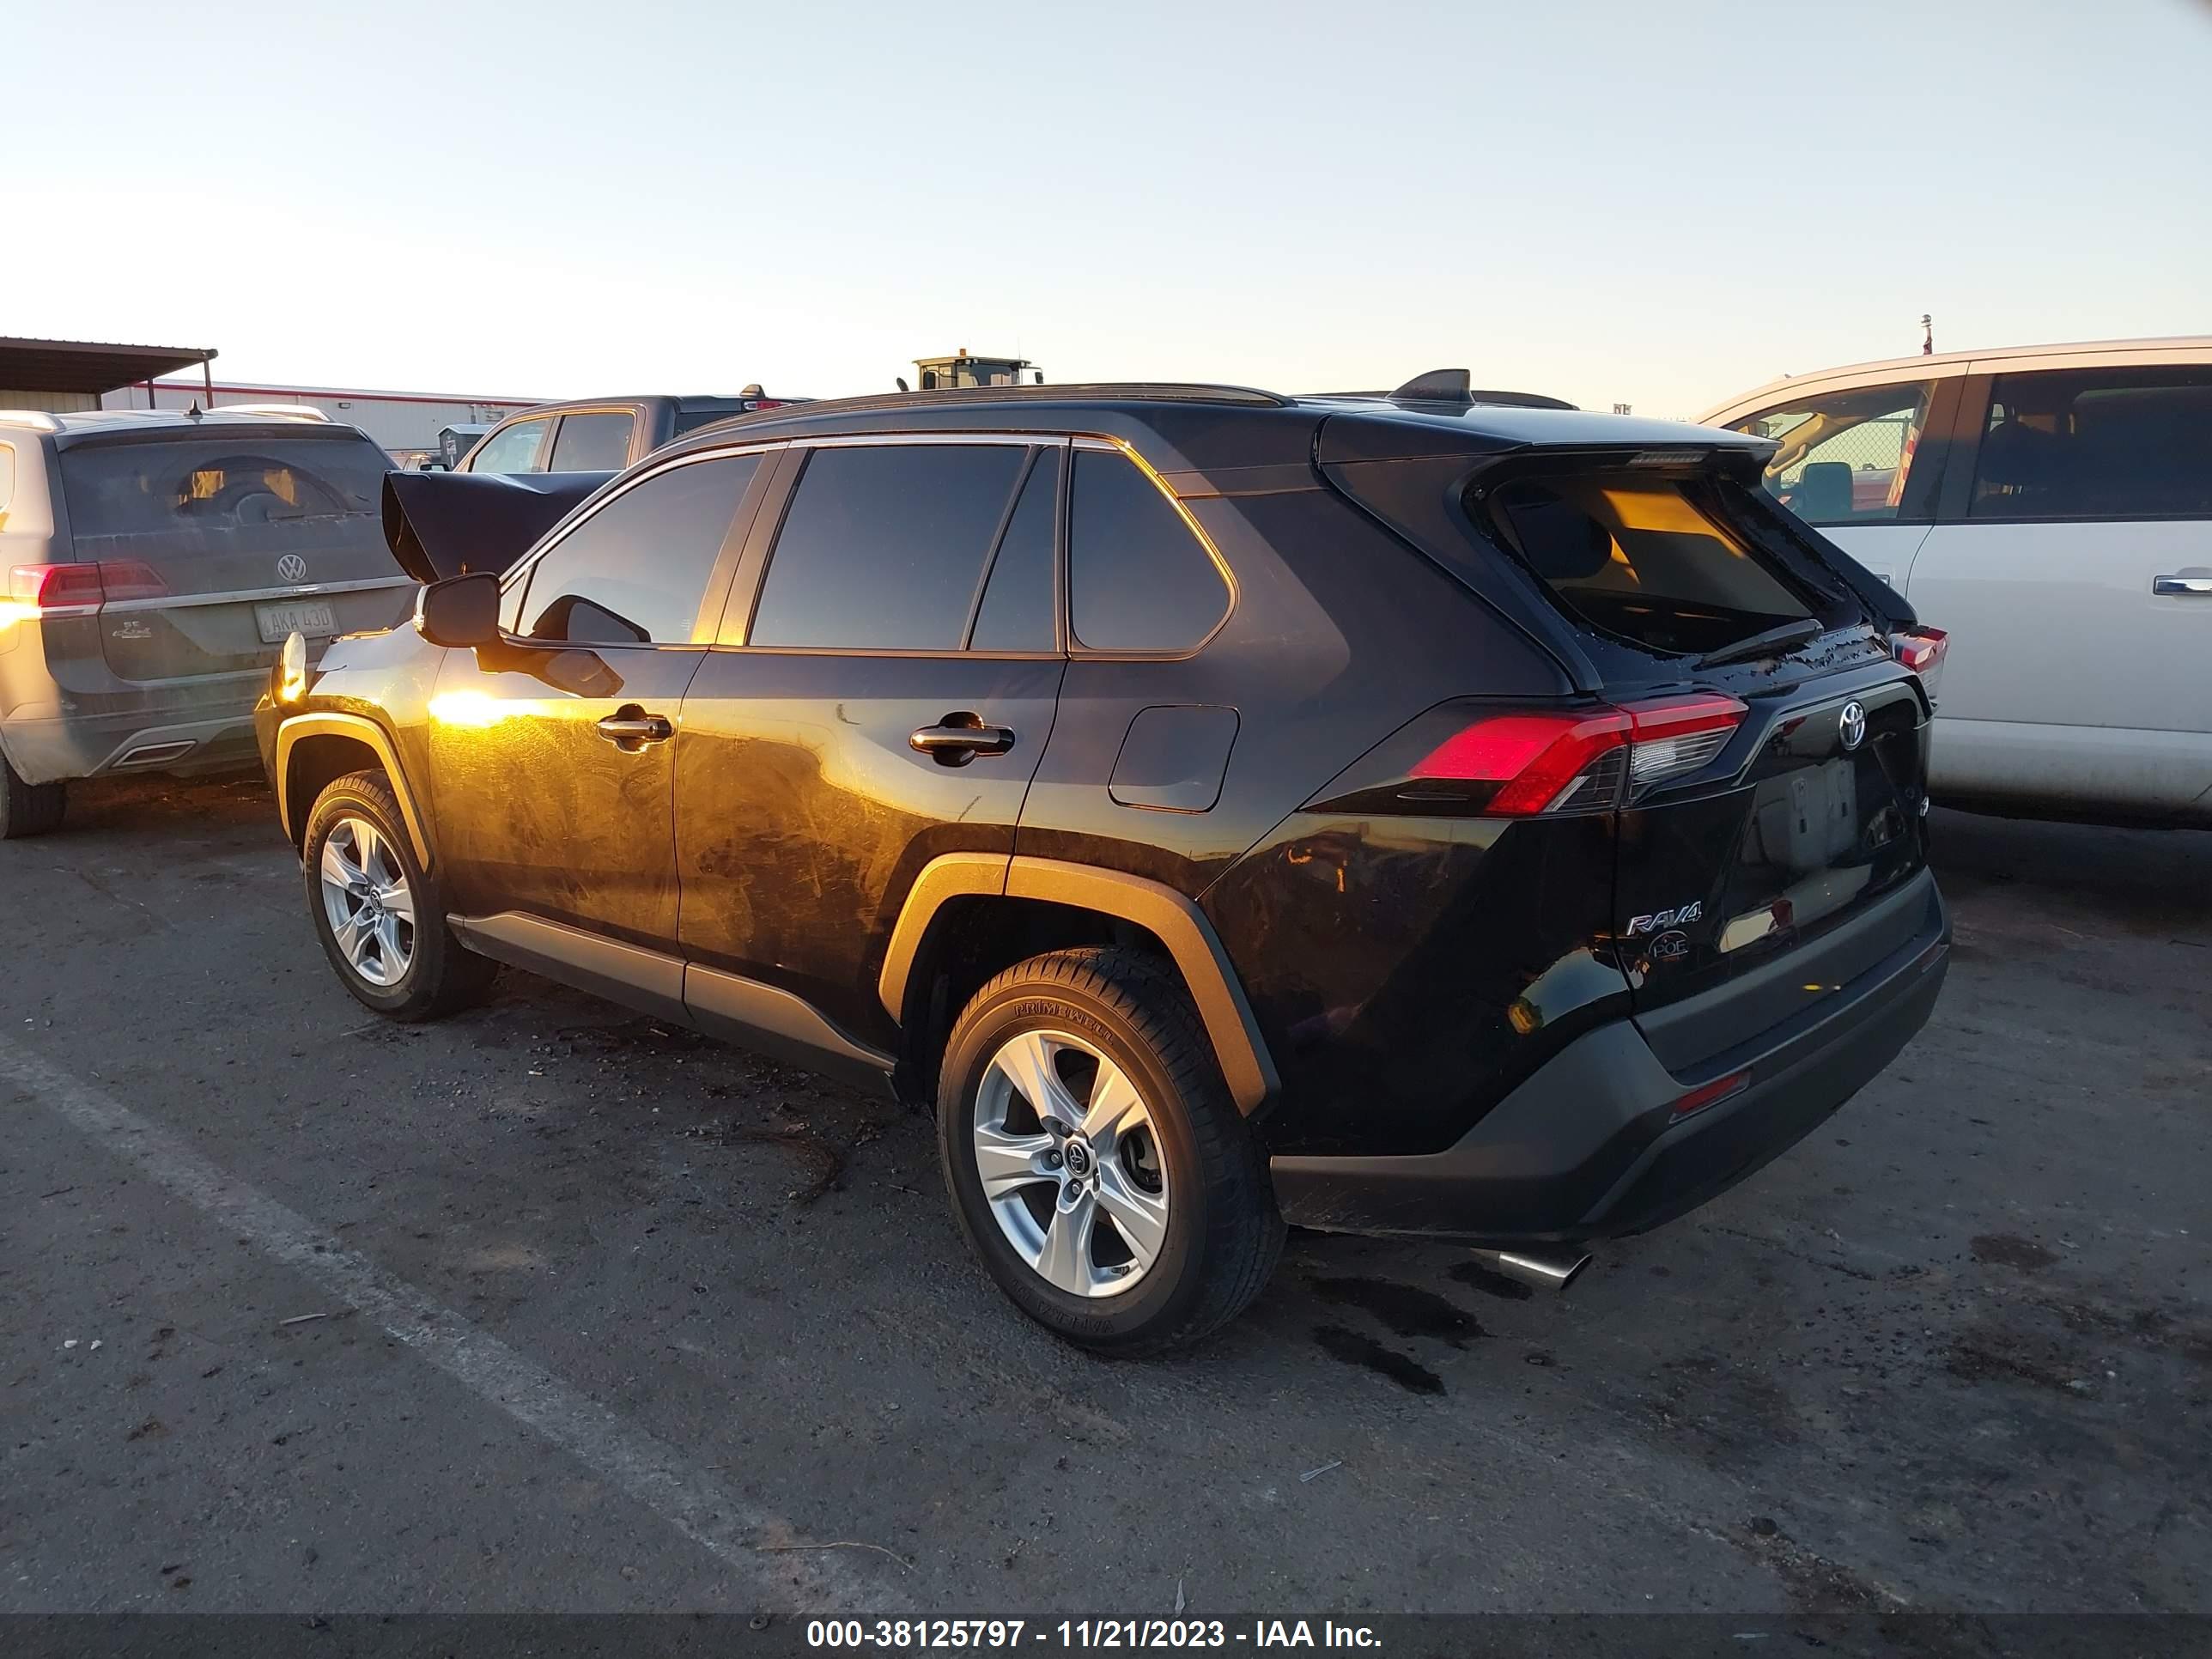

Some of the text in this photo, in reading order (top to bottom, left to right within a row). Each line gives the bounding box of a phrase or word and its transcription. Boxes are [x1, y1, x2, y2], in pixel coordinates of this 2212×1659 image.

[271, 611, 299, 632] AKA
[1626, 900, 1702, 936] RAV4
[1013, 1000, 1115, 1046] PRIMEWELL
